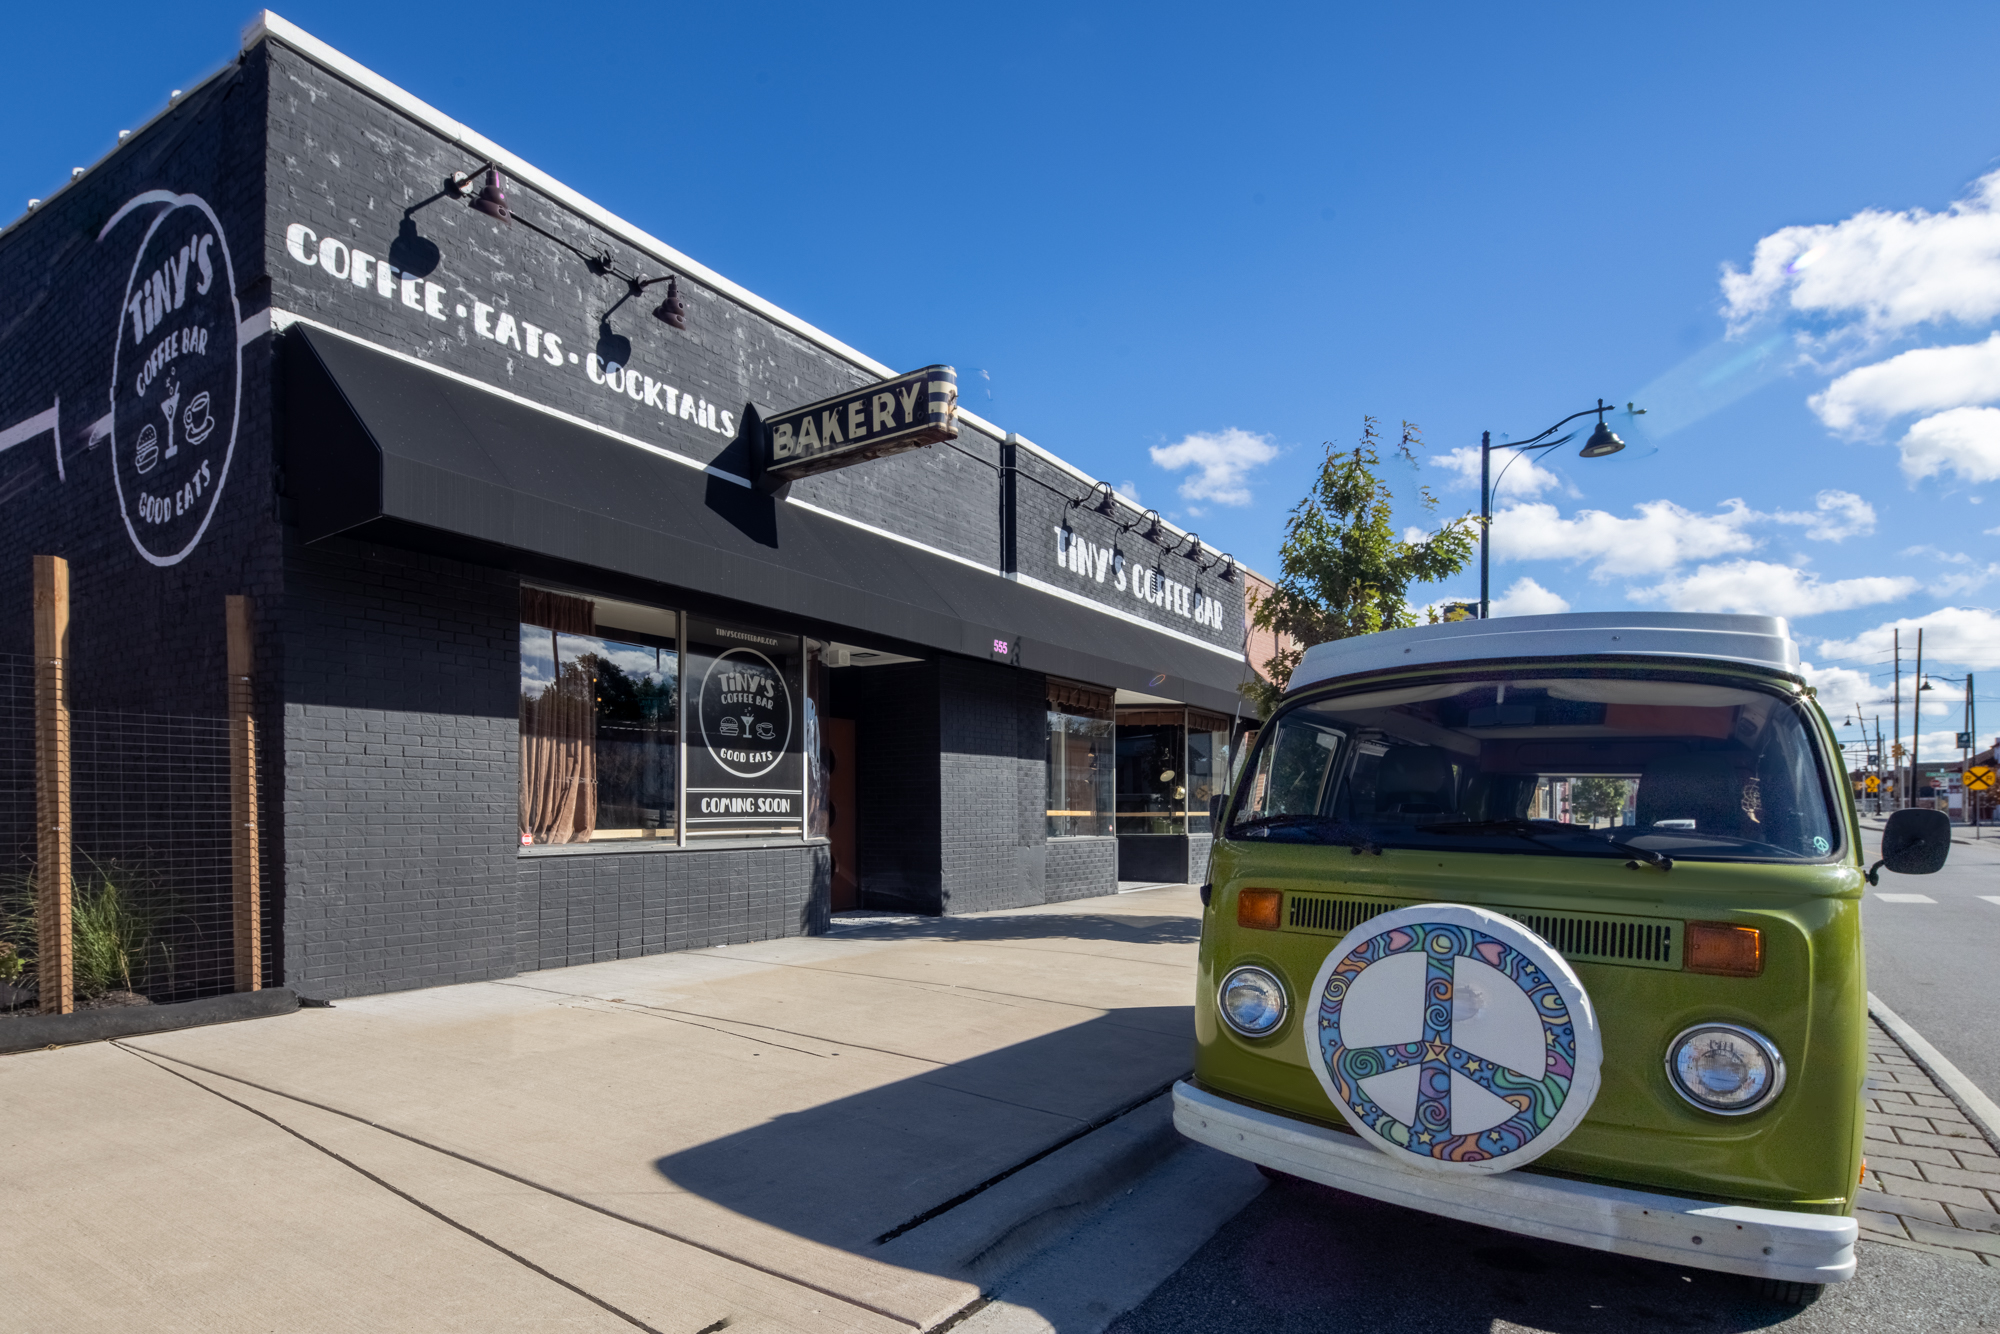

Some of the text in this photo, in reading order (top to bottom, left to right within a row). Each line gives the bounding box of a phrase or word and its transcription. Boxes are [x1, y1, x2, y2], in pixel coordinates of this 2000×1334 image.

[128, 233, 214, 345] TiNY'S
[286, 223, 447, 321] COFFEE
[474, 302, 564, 367] EATS
[136, 325, 208, 397] COFFEE BAR
[772, 381, 923, 461] BAKERY
[138, 458, 210, 525] GOOD EATS
[1053, 525, 1223, 631] TiNY'S COFFEE BAR
[715, 627, 778, 646] TINYSCOFFEEBAR.COM
[993, 638, 1008, 655] 555
[717, 672, 775, 698] TiNY'S
[720, 692, 774, 710] COFFEE BAR
[720, 747, 773, 763] GOOD EATS
[701, 797, 790, 814] COMING SOON
